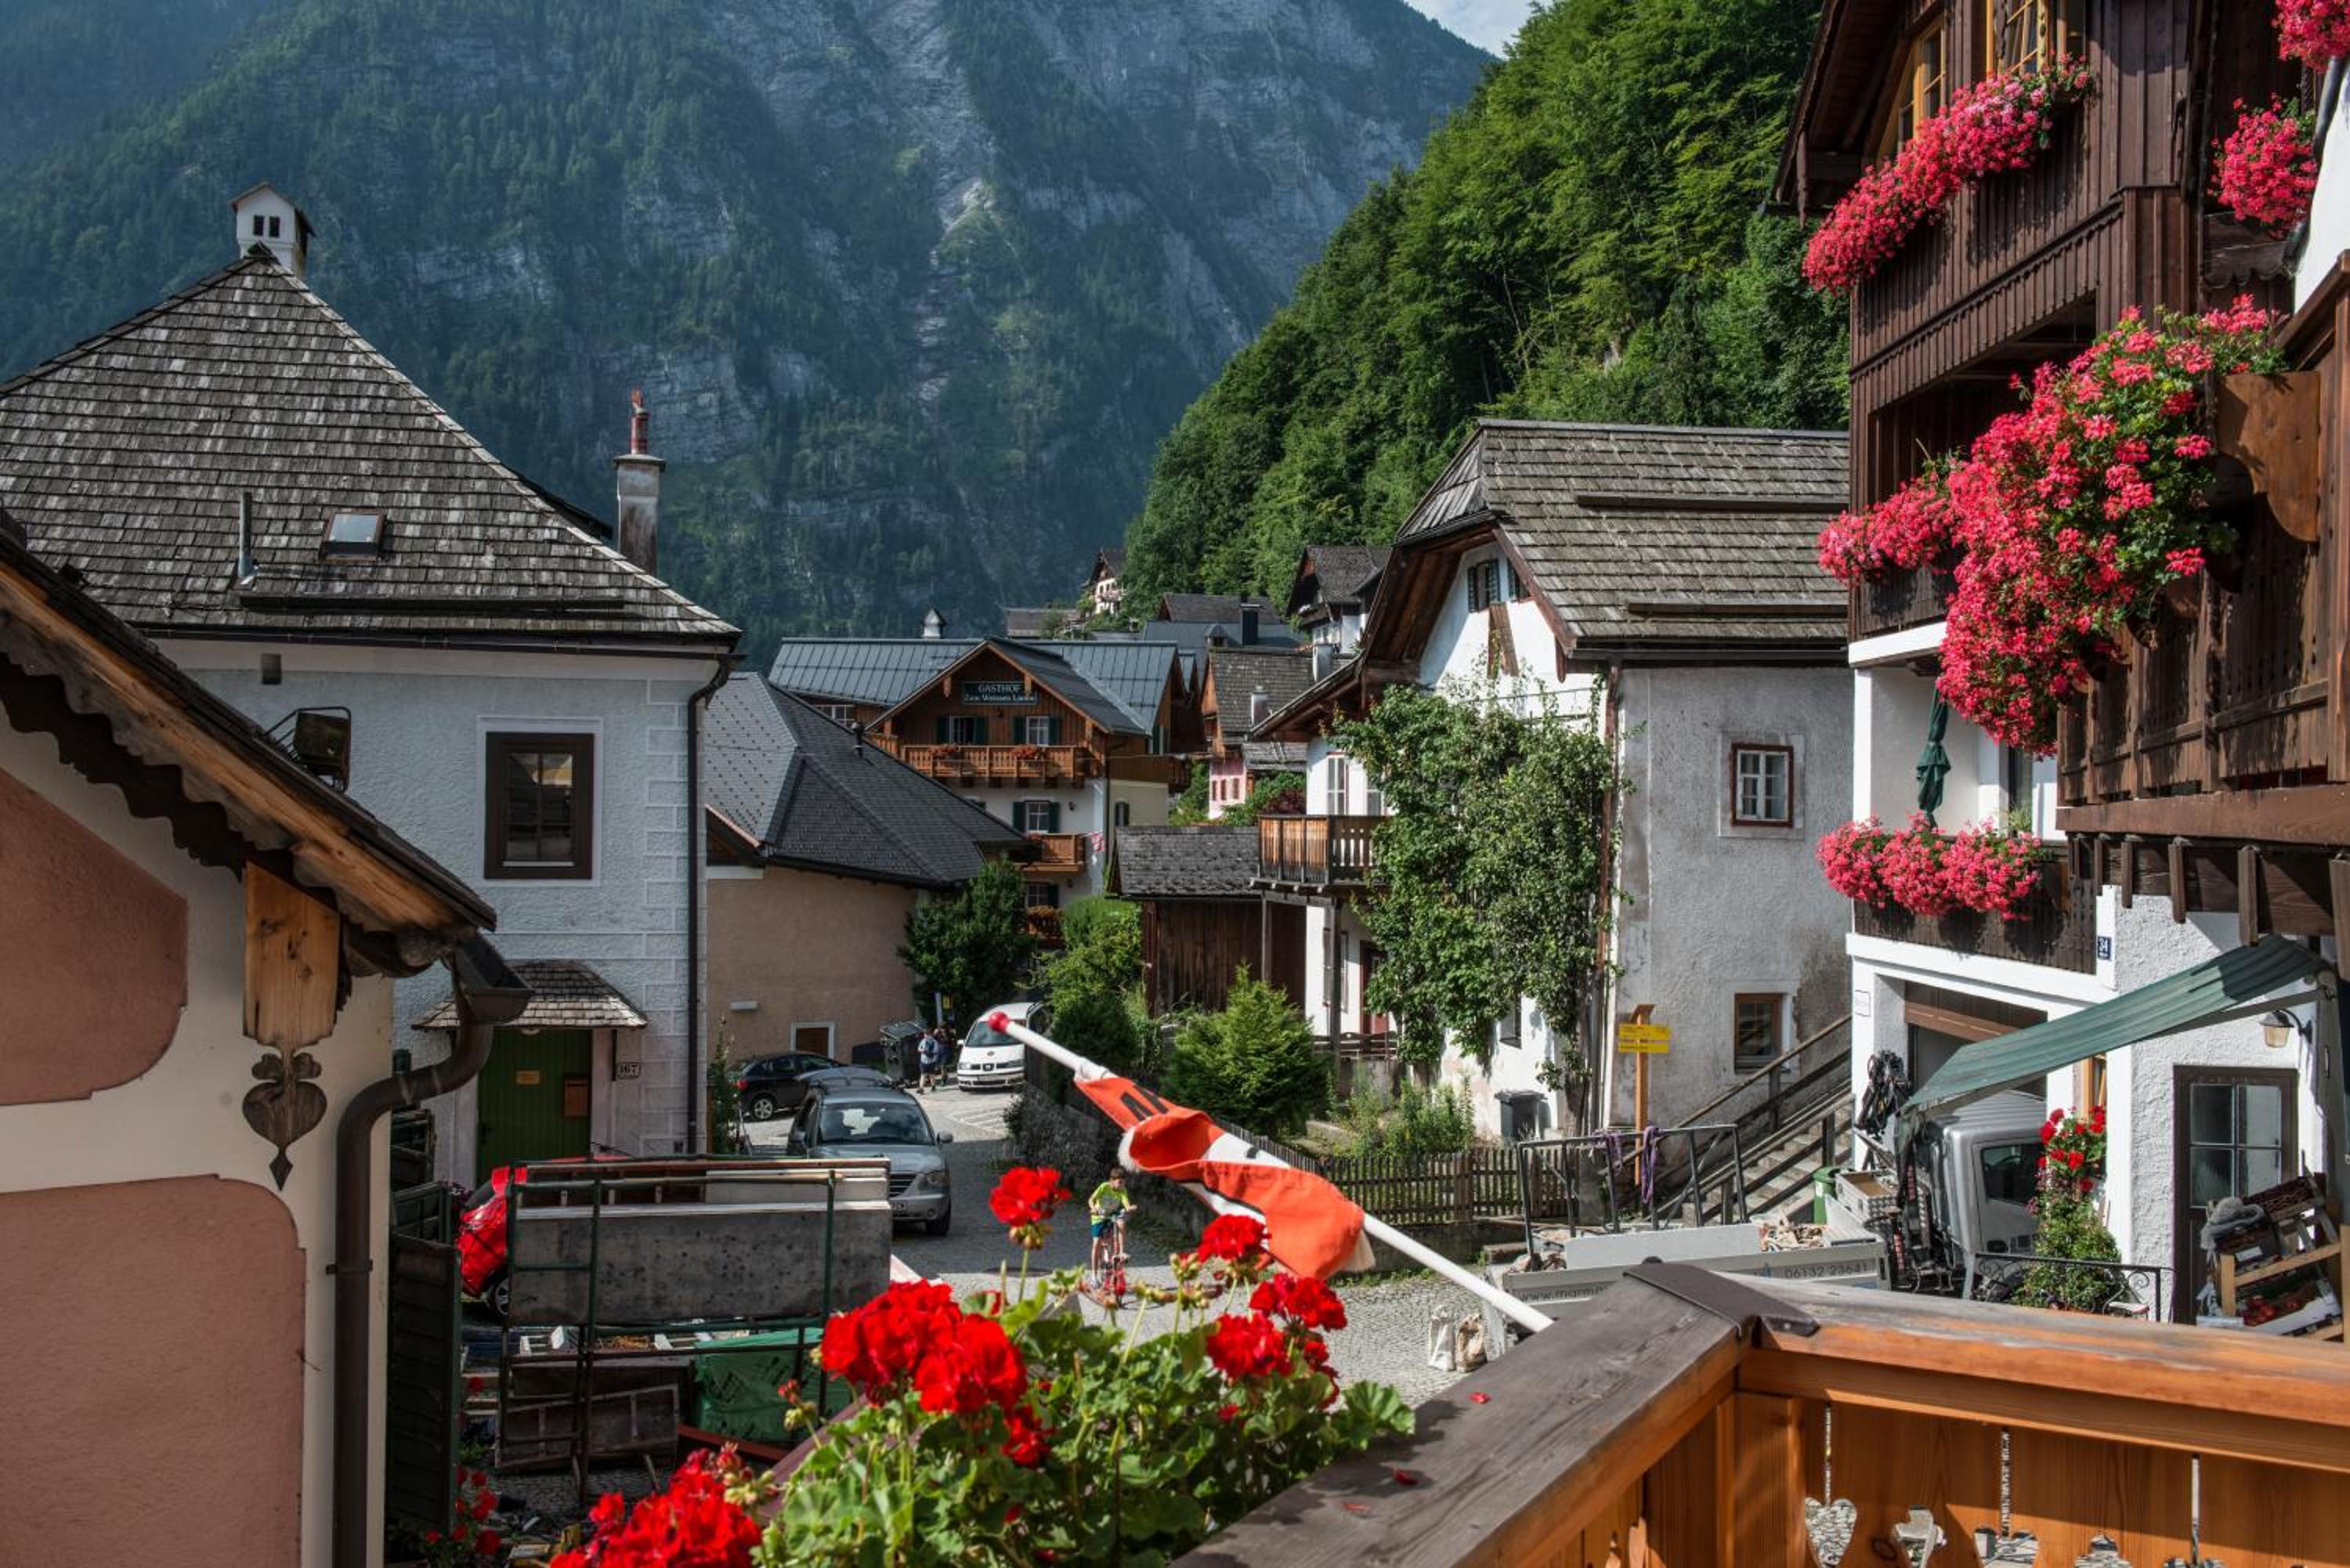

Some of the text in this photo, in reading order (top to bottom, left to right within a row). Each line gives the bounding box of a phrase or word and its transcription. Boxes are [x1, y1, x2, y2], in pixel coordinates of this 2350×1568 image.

[978, 684, 1022, 693] GASTHOF
[2099, 938, 2109, 952] 34
[1784, 1262, 1868, 1278] 06132 23641
